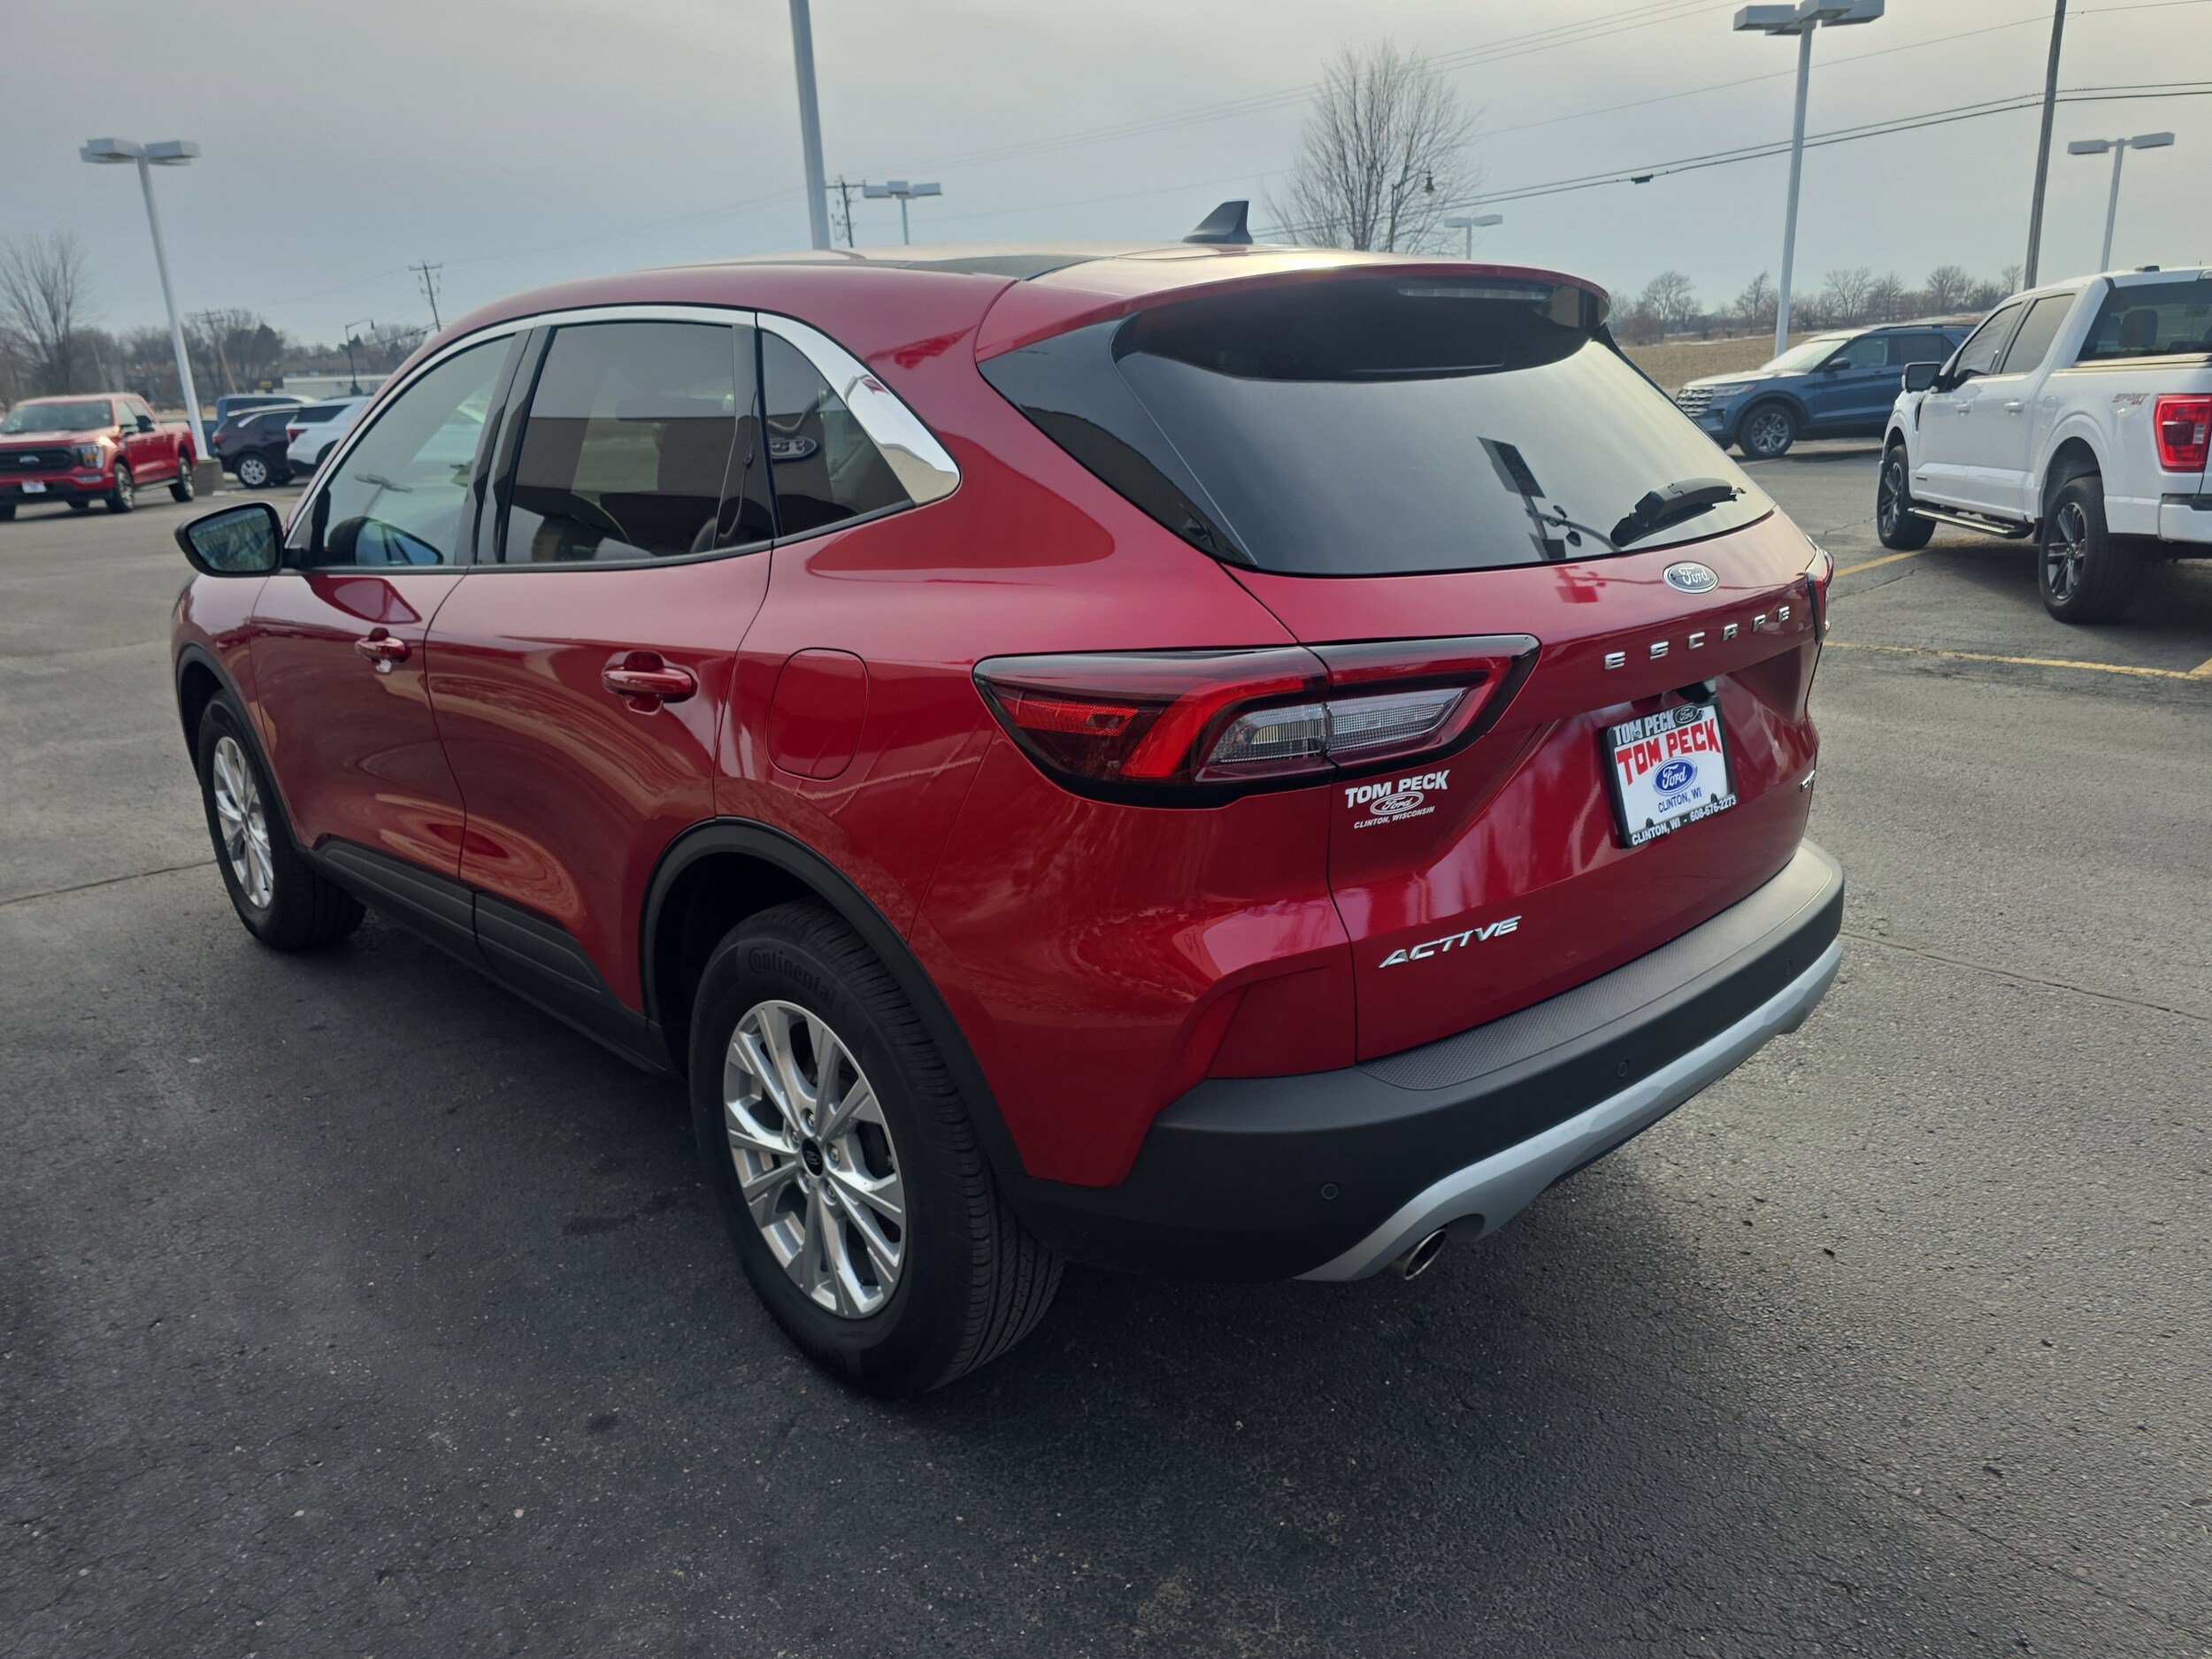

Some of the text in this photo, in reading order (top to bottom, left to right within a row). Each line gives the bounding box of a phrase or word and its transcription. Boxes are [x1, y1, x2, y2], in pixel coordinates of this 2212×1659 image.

[1678, 565, 1710, 585] Ford
[1604, 605, 1790, 670] ESCAPE
[1613, 709, 1677, 745] TOM PECK
[1616, 718, 1721, 786] TOM PECK
[1345, 769, 1450, 809] TOM PECK
[1662, 764, 1687, 789] Ford
[1381, 795, 1414, 810] Ford
[1657, 787, 1702, 813] CLINTON, WI
[1354, 806, 1435, 829] CLINTON, WISCONSIN
[1632, 823, 1671, 845] CLINTON,
[1670, 818, 1681, 830] WI
[1379, 915, 1523, 968] ACTIVE
[748, 947, 838, 1008] Continental
